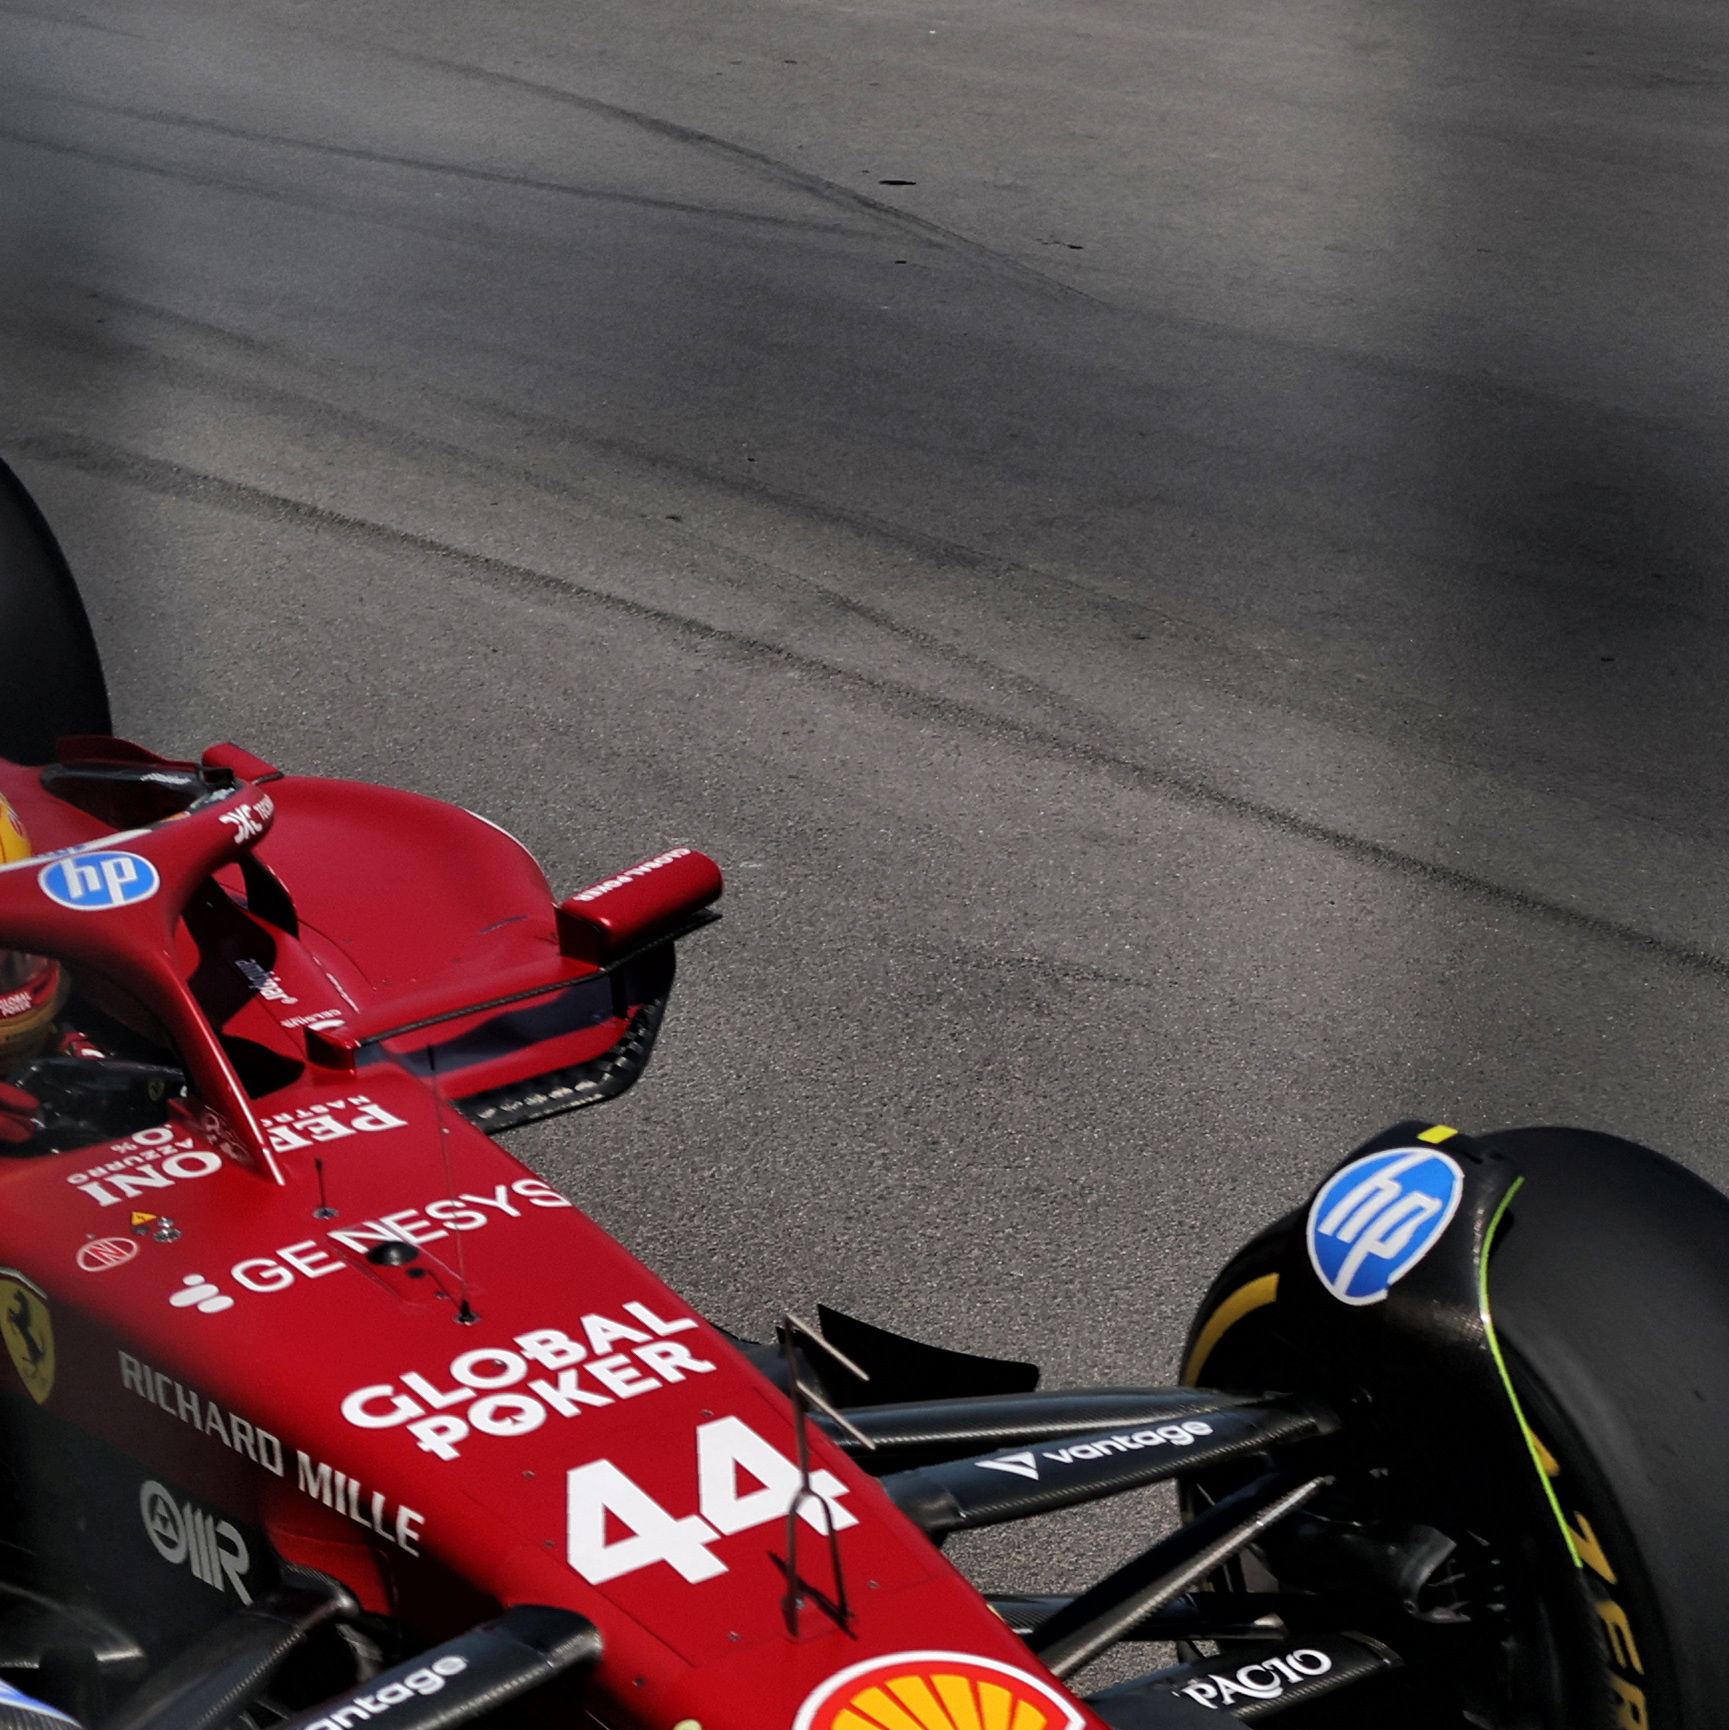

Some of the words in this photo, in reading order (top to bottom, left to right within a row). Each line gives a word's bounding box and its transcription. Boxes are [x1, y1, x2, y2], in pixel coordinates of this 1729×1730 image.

[66, 1138, 196, 1186] AZZURRO
[230, 1178, 573, 1293] GENESYS
[1314, 1148, 1444, 1302] hp
[340, 1300, 698, 1428] GLOBAL
[406, 1340, 717, 1461] POKER
[117, 1350, 285, 1478] RICHARD
[296, 1449, 426, 1558] MILLE
[566, 1415, 860, 1585] 44
[1041, 1418, 1215, 1465] vantage
[1180, 1648, 1333, 1711] PACIO
